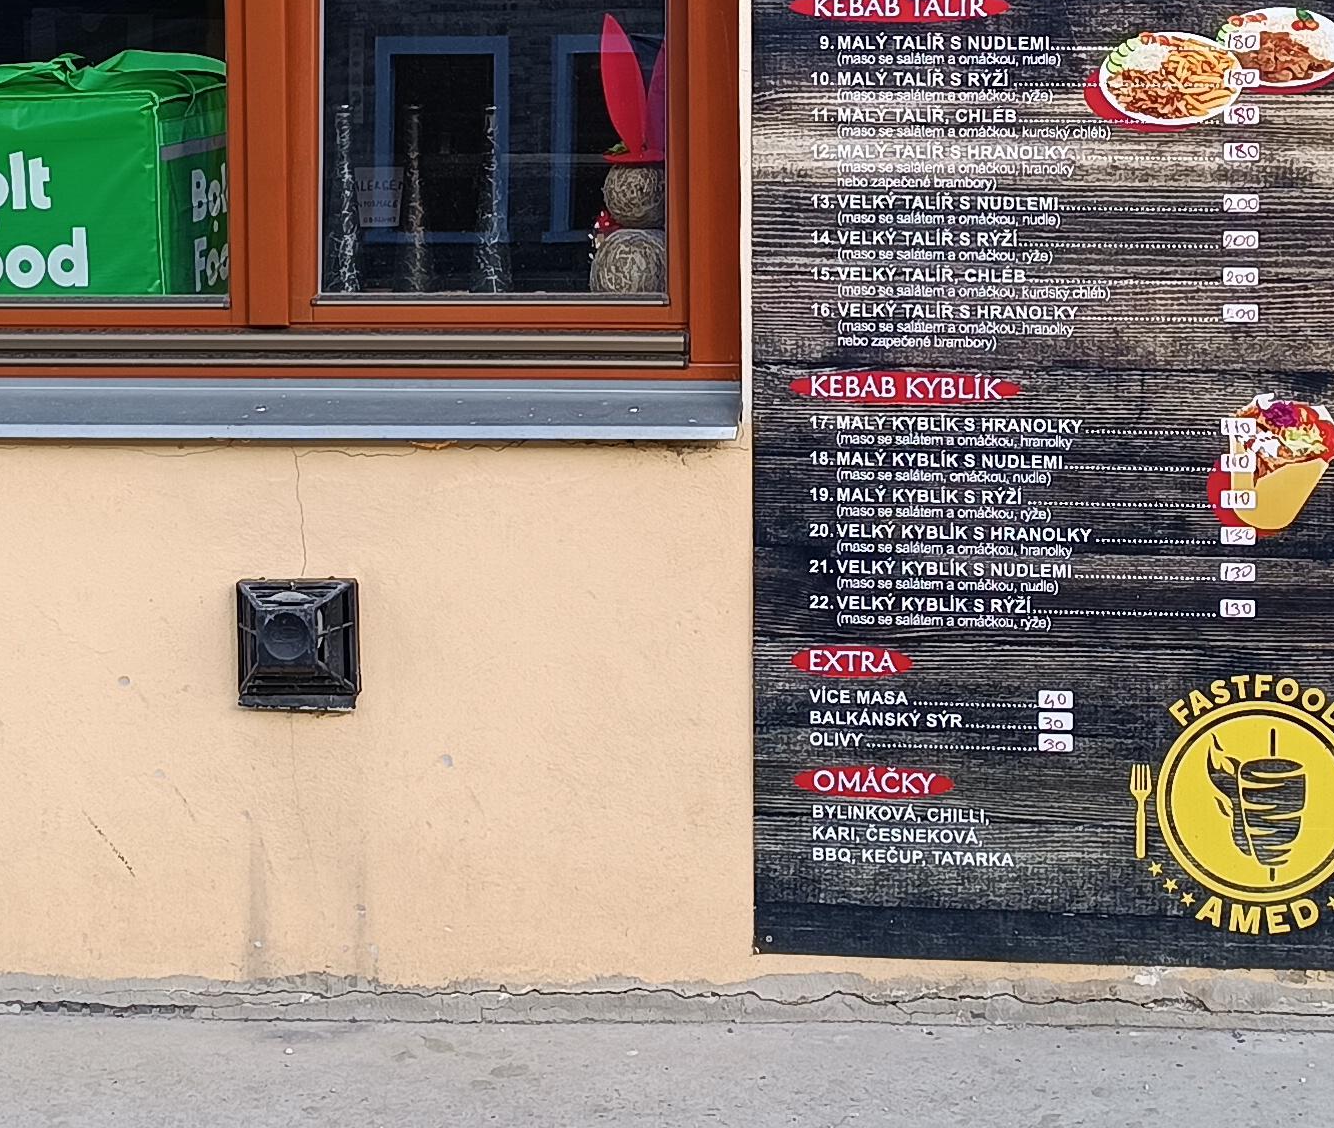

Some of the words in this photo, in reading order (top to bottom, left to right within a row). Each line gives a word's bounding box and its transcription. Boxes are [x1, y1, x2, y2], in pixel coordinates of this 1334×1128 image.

[820, 36, 834, 50] 9.
[838, 32, 886, 50] MALÝ
[893, 32, 945, 50] TALÍŘ
[950, 36, 961, 50] S
[968, 36, 1050, 51] NUDLEMI
[192, 163, 229, 222] Bol
[811, 304, 835, 318] 16.
[838, 300, 896, 318] VELKÝ
[903, 300, 954, 319] TALÍŘ
[960, 305, 970, 320] S
[976, 306, 1078, 320] HRANOLKY
[811, 375, 896, 398] KEBAB
[907, 374, 1001, 400] KYBLÍK
[810, 451, 834, 465] 18.
[837, 447, 886, 466] MALÝ
[893, 448, 958, 468] KYBLÍK
[965, 454, 975, 468] S
[982, 455, 1063, 469] NUDLEMI
[810, 596, 834, 610] 22.
[837, 592, 896, 611] VELKÝ
[902, 593, 967, 612] KYBLÍK
[974, 599, 985, 612] S
[990, 593, 1032, 613] RÝŽÍ
[810, 650, 897, 672] EXTRA
[810, 686, 850, 704] VÍCE
[857, 691, 908, 705] MASA
[810, 707, 920, 726] BALKÁNSKÝ
[926, 708, 962, 728] SÝR
[1043, 718, 1063, 730] 30
[810, 733, 863, 747] OLIVY
[813, 768, 936, 794] OMÁČKY
[812, 802, 922, 823] BYLINKOVÁ,
[927, 808, 989, 825] CHILLI,
[812, 827, 860, 844] KARI,
[866, 824, 983, 846] ČESNEKOVÁ,
[813, 848, 856, 864] BBQ,
[862, 846, 925, 866] KEČUP,
[932, 852, 1014, 867] TATARKA
[1195, 896, 1319, 935] AMED
